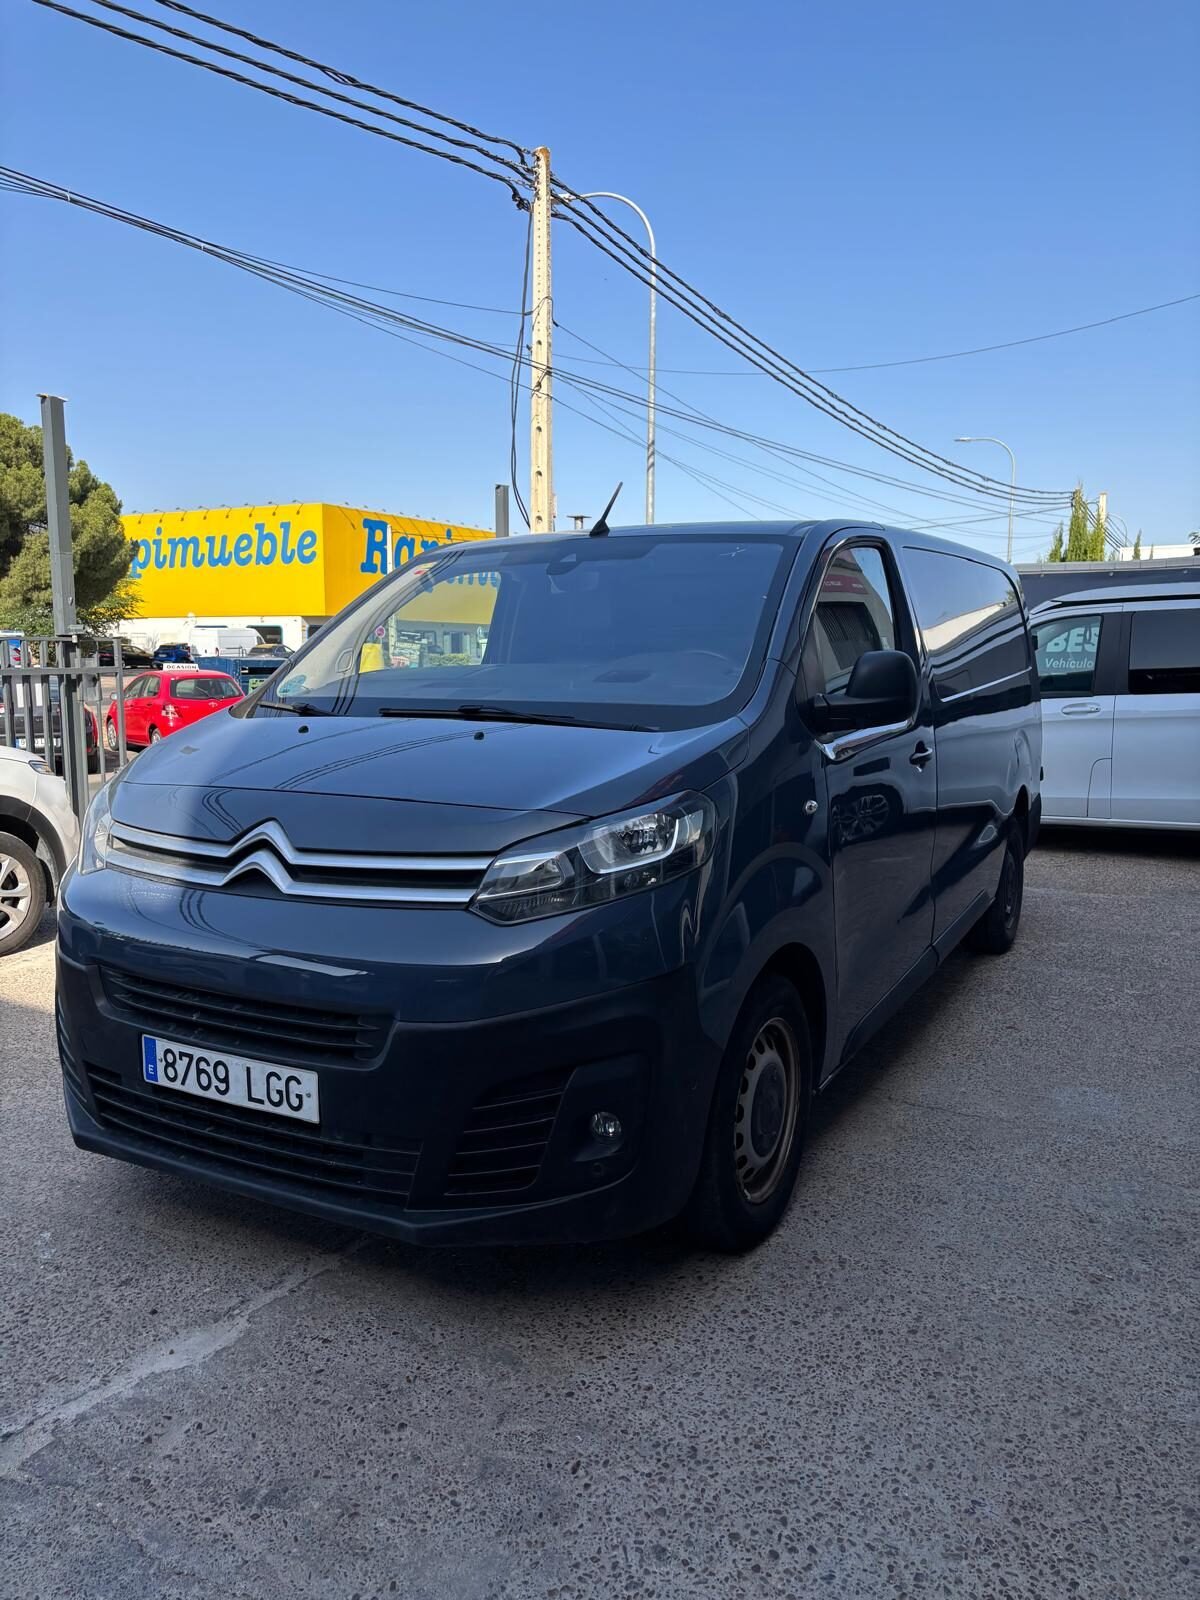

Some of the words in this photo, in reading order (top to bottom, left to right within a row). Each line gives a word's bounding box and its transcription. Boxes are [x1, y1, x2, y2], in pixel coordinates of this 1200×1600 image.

[148, 1064, 155, 1075] E
[163, 1048, 230, 1096] 8769
[246, 1066, 303, 1112] LGG
